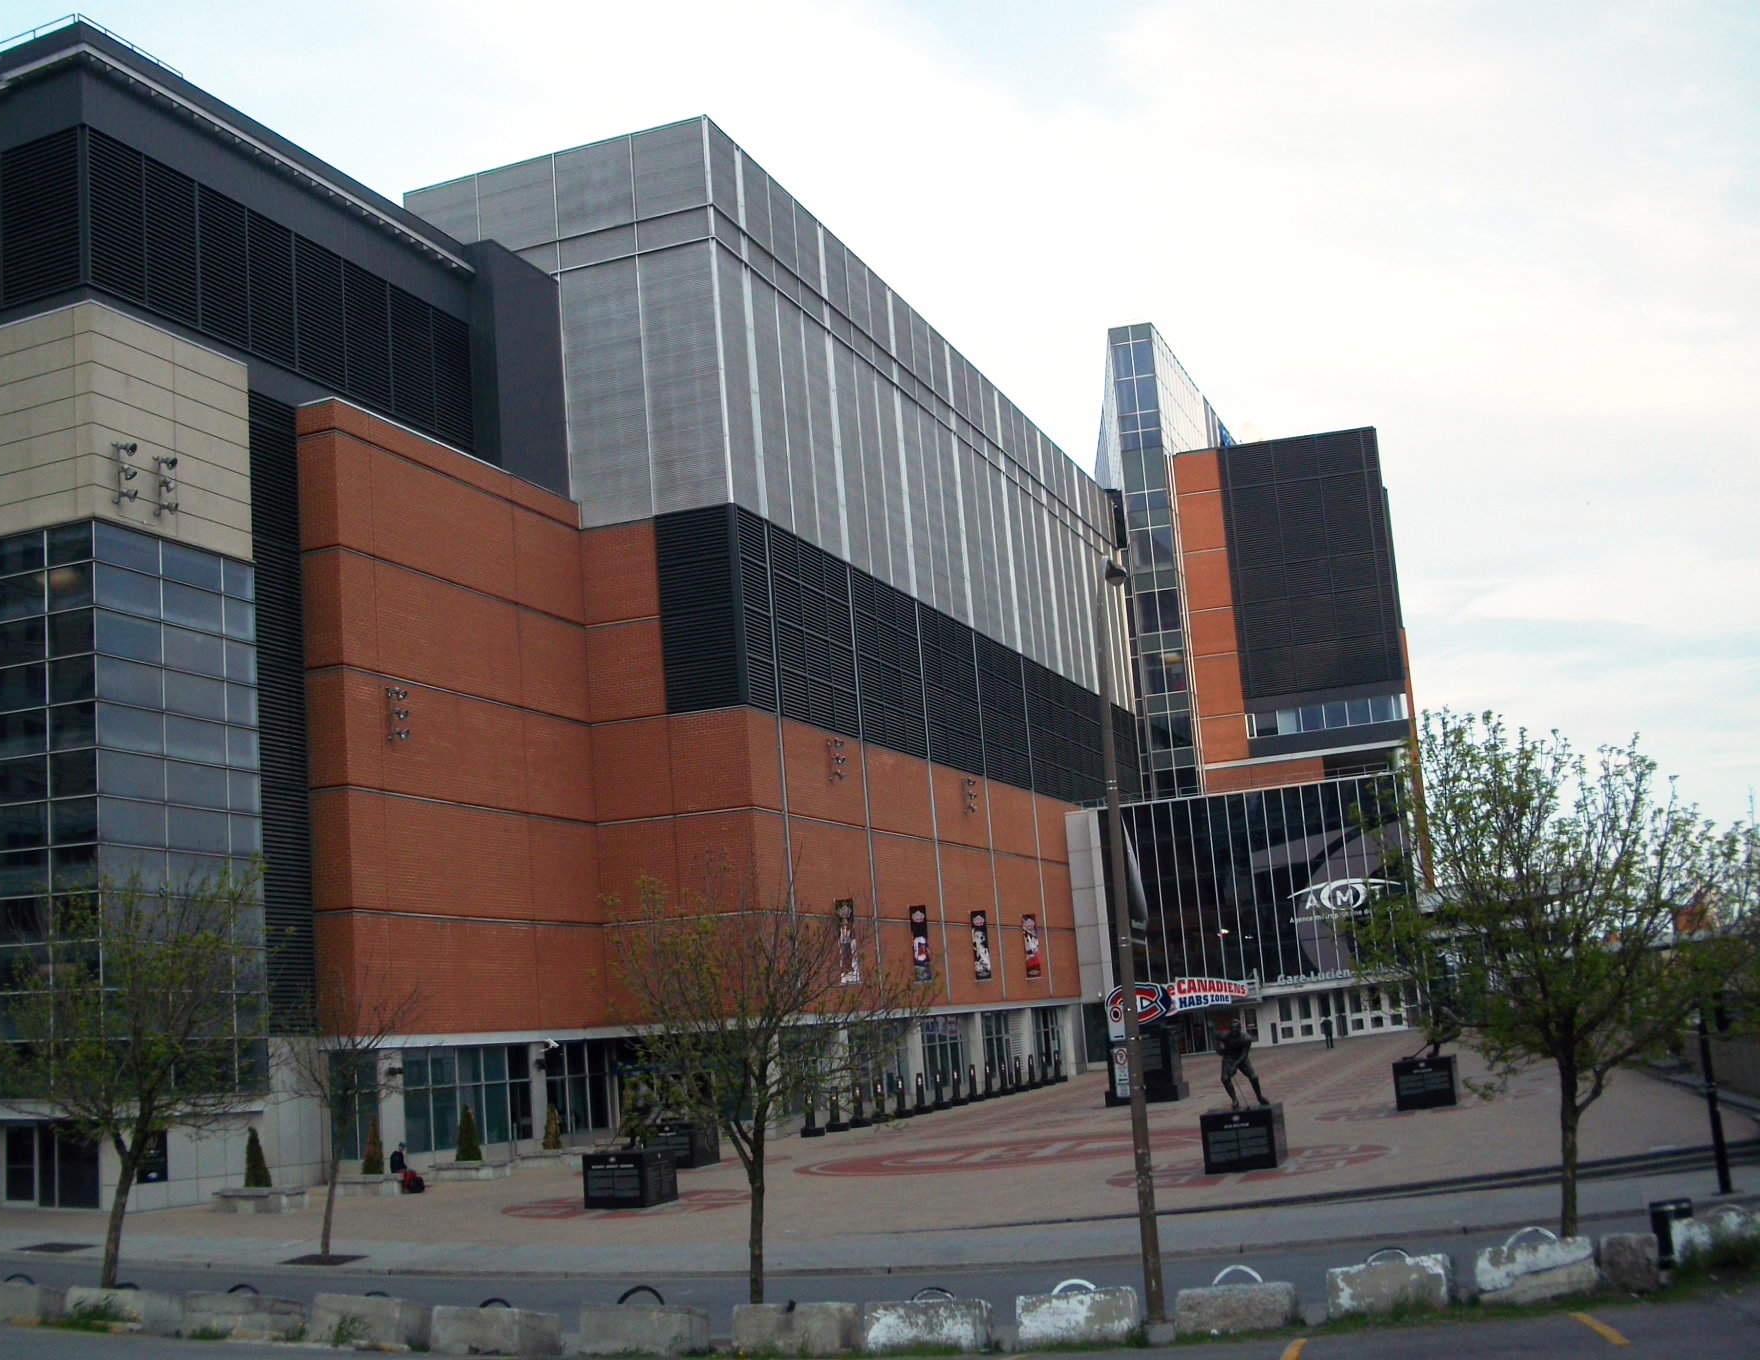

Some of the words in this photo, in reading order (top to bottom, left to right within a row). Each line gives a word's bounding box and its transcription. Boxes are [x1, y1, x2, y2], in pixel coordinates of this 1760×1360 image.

[1176, 979, 1246, 995] CANADIENS
[1277, 973, 1306, 985] Gare
[1179, 994, 1209, 1009] HABS
[1209, 993, 1230, 1004] zone
